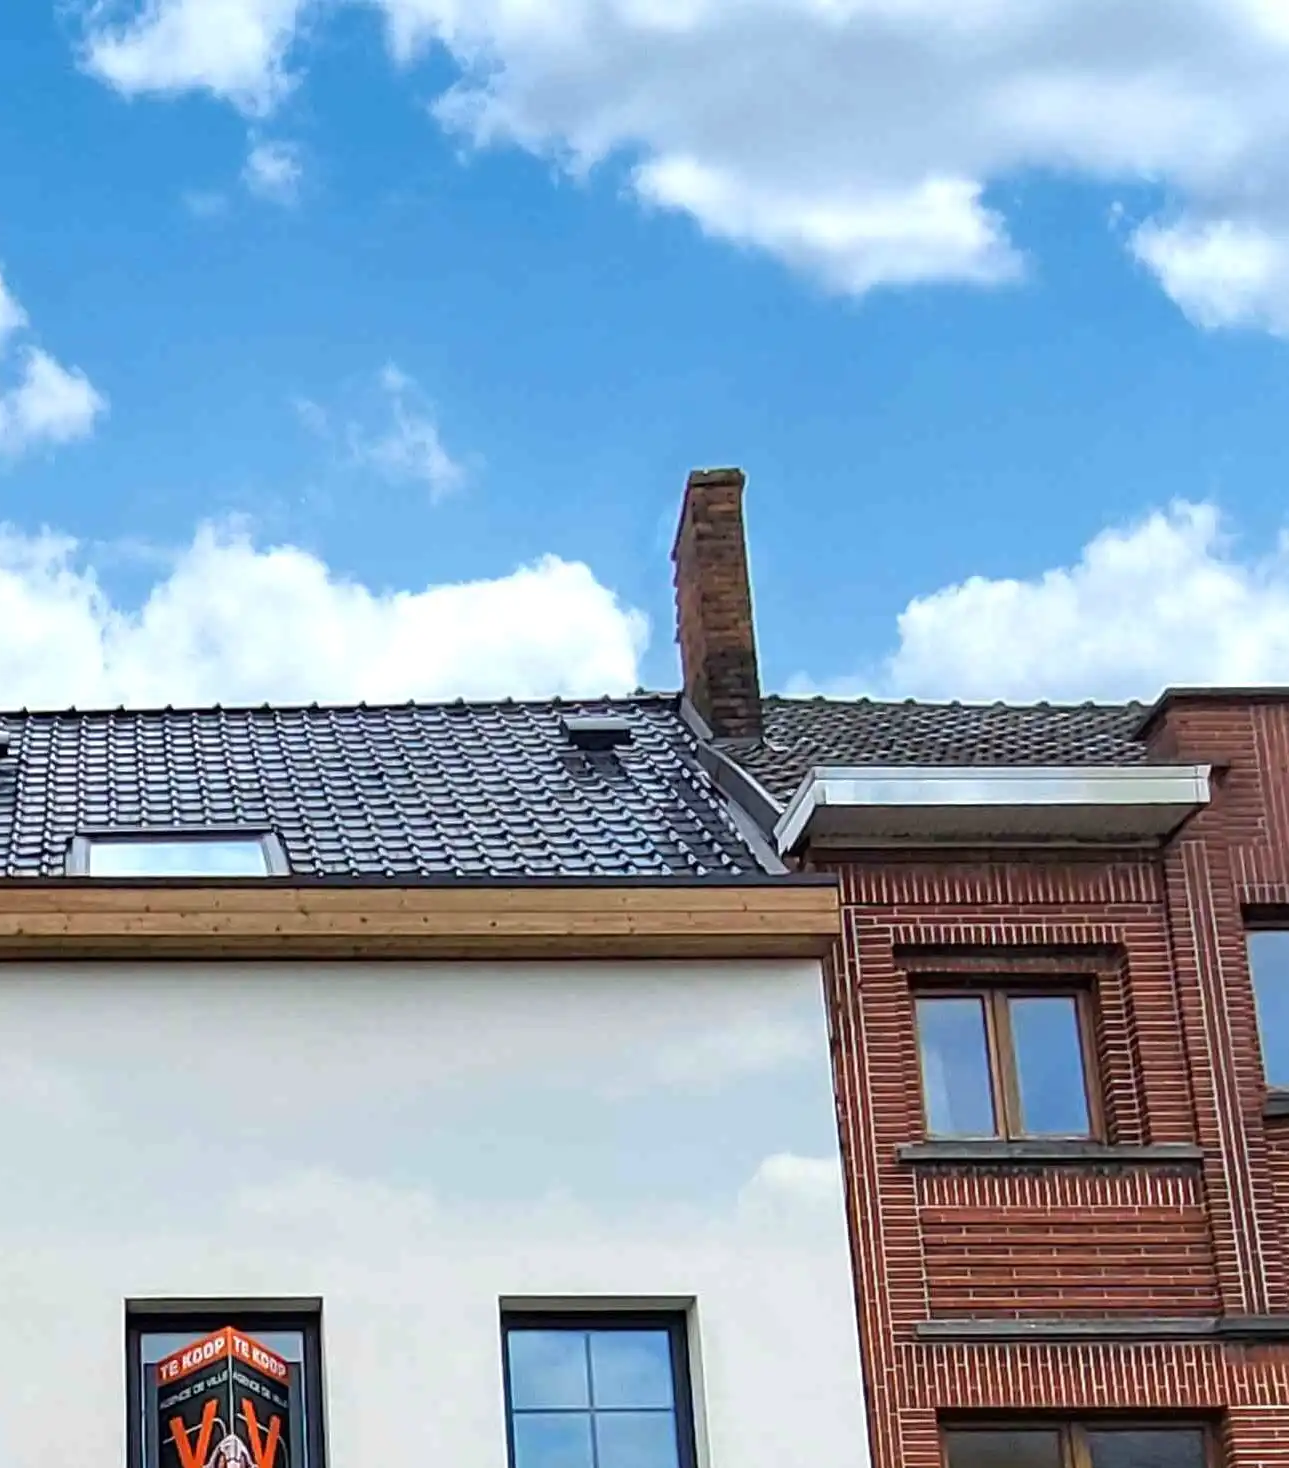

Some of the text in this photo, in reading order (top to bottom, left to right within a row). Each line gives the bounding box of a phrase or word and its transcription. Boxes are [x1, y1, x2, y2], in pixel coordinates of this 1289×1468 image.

[160, 1336, 225, 1380] TE KOOP
[233, 1335, 287, 1376] TE KOOP
